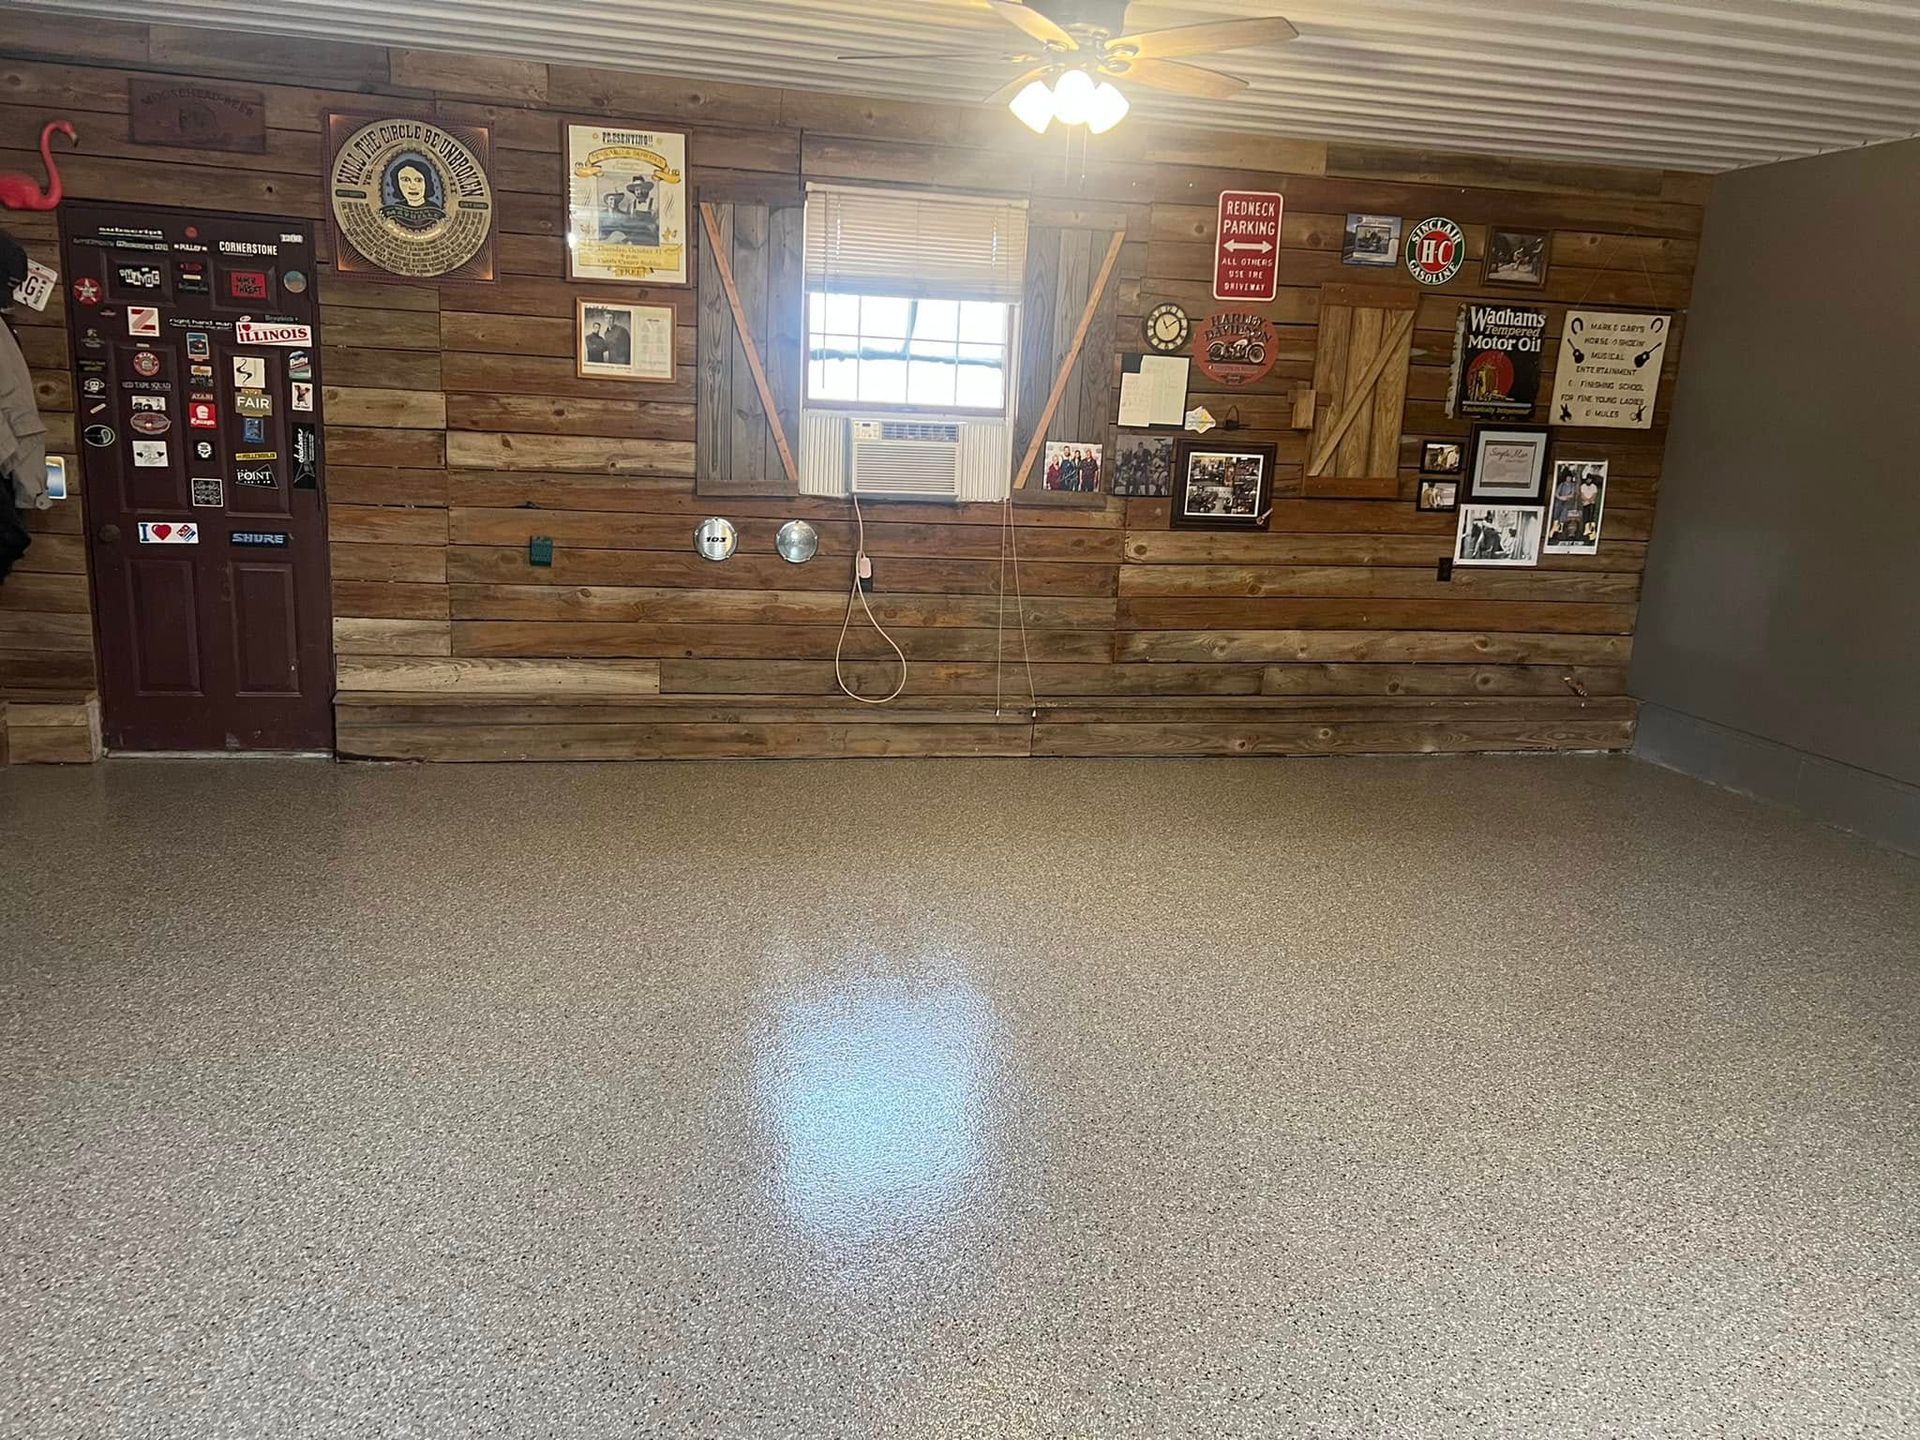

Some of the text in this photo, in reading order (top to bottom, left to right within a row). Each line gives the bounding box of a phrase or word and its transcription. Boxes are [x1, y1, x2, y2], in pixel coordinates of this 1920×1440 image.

[337, 124, 484, 198] WILL THE CIRCLE BE UNBROKEN
[1227, 201, 1275, 217] REDNECK
[1223, 220, 1276, 236] PARKING
[1411, 219, 1461, 244] SINCLAIR
[219, 241, 278, 256] CORNERSTONE
[1222, 257, 1273, 267] ALL OTHERS
[1229, 270, 1263, 279] USE THE
[1409, 259, 1459, 284] GASOLINE
[1224, 282, 1265, 291] DRIVEWAY
[1211, 313, 1263, 327] HARLEY
[1470, 306, 1546, 331] Wadhams
[239, 327, 307, 342] ILLINOIS
[1485, 325, 1540, 339] Tempered
[1468, 335, 1541, 352] Motor Oil
[1591, 352, 1625, 360] MUSICAL
[1576, 366, 1637, 376] ENTERTAINMENT
[1580, 380, 1615, 389] FINISHING
[1618, 383, 1644, 391] SCHOOL
[191, 393, 213, 401] ATARI
[237, 397, 270, 409] FAIR
[1595, 396, 1617, 404] YOUNG
[1620, 398, 1644, 406] LADIES
[1594, 410, 1619, 418] MULES
[236, 471, 271, 481] POINT
[140, 523, 149, 542] I
[232, 533, 285, 544] SHURE
